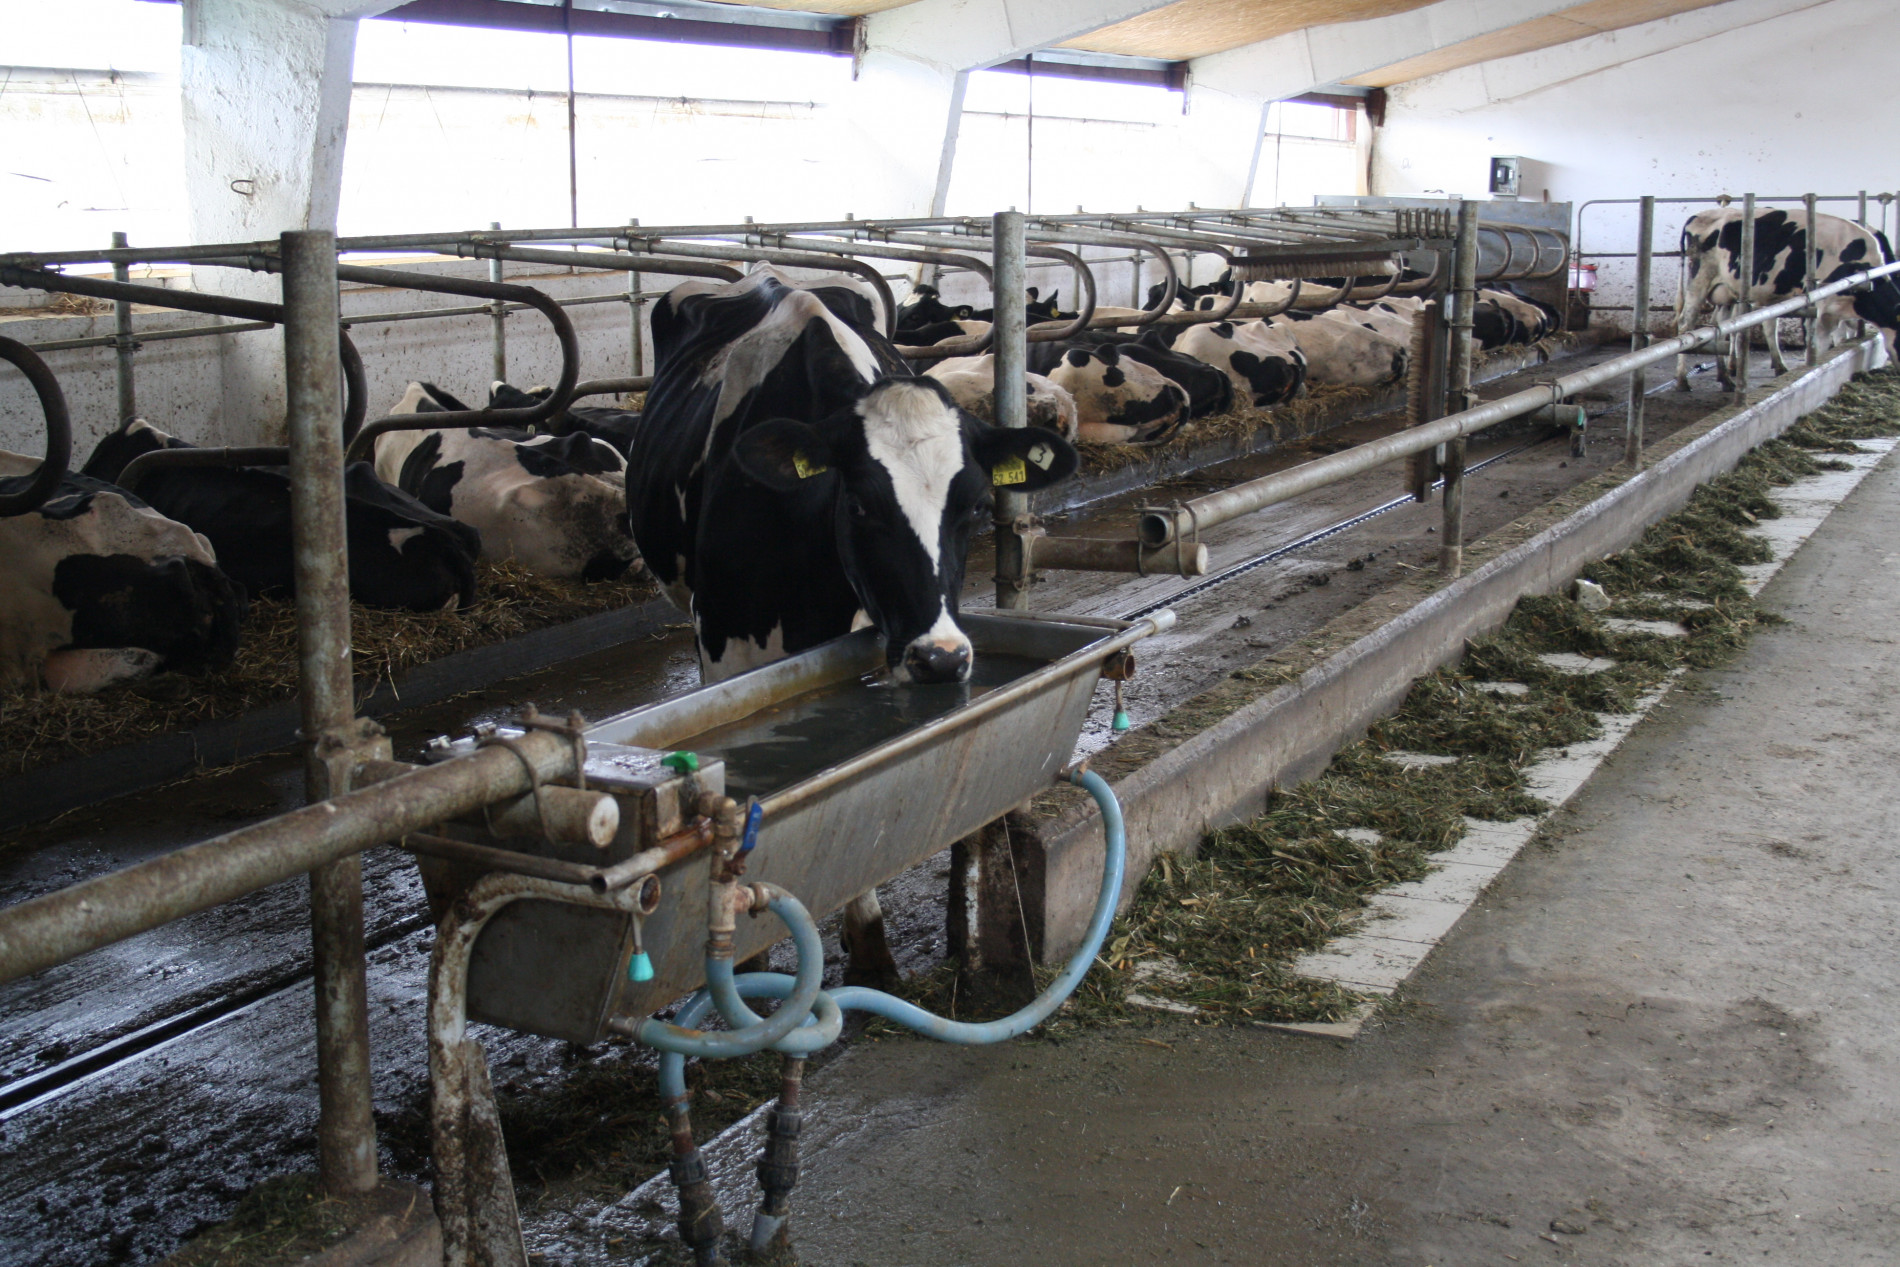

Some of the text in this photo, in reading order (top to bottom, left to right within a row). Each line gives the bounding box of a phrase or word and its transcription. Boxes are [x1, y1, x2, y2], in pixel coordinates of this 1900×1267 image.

[1035, 444, 1047, 463] 3
[993, 470, 1024, 484] 52 541
